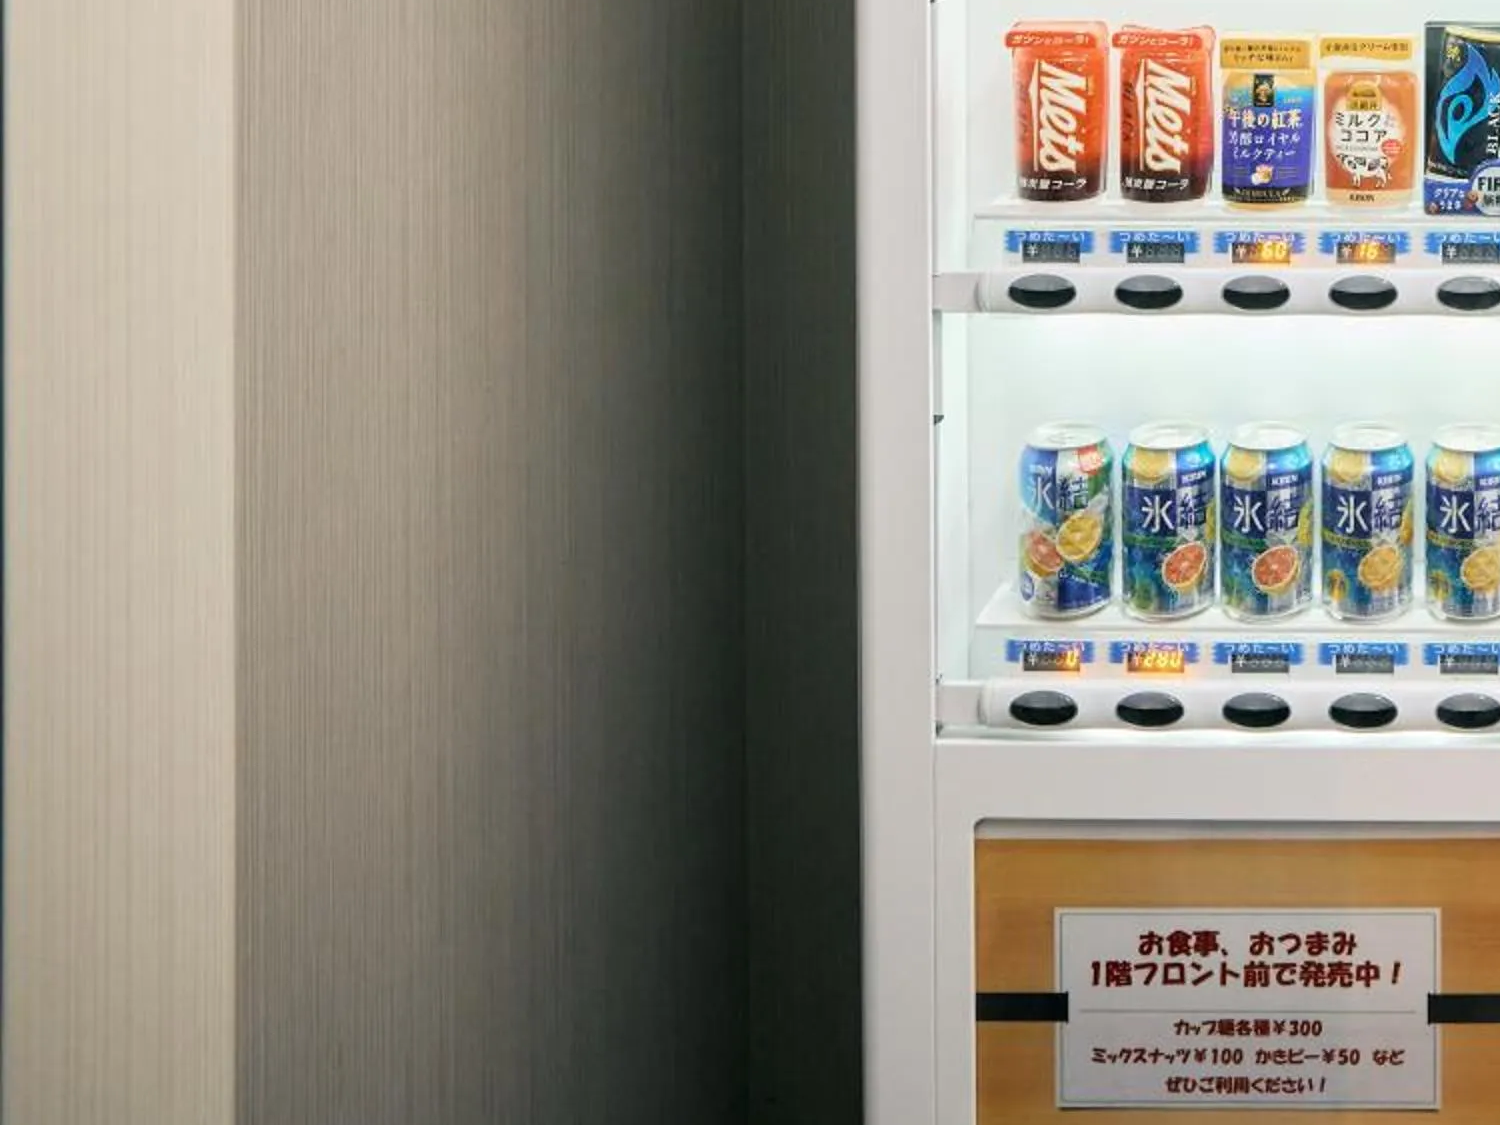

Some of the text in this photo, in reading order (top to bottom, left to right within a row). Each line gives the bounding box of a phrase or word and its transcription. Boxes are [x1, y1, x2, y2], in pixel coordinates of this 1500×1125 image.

[1224, 108, 1303, 129] 午後の紅茶
[1340, 130, 1388, 144] ココア
[1138, 930, 1358, 957] お食事、 おつまみ
[1372, 1049, 1406, 1066] など
